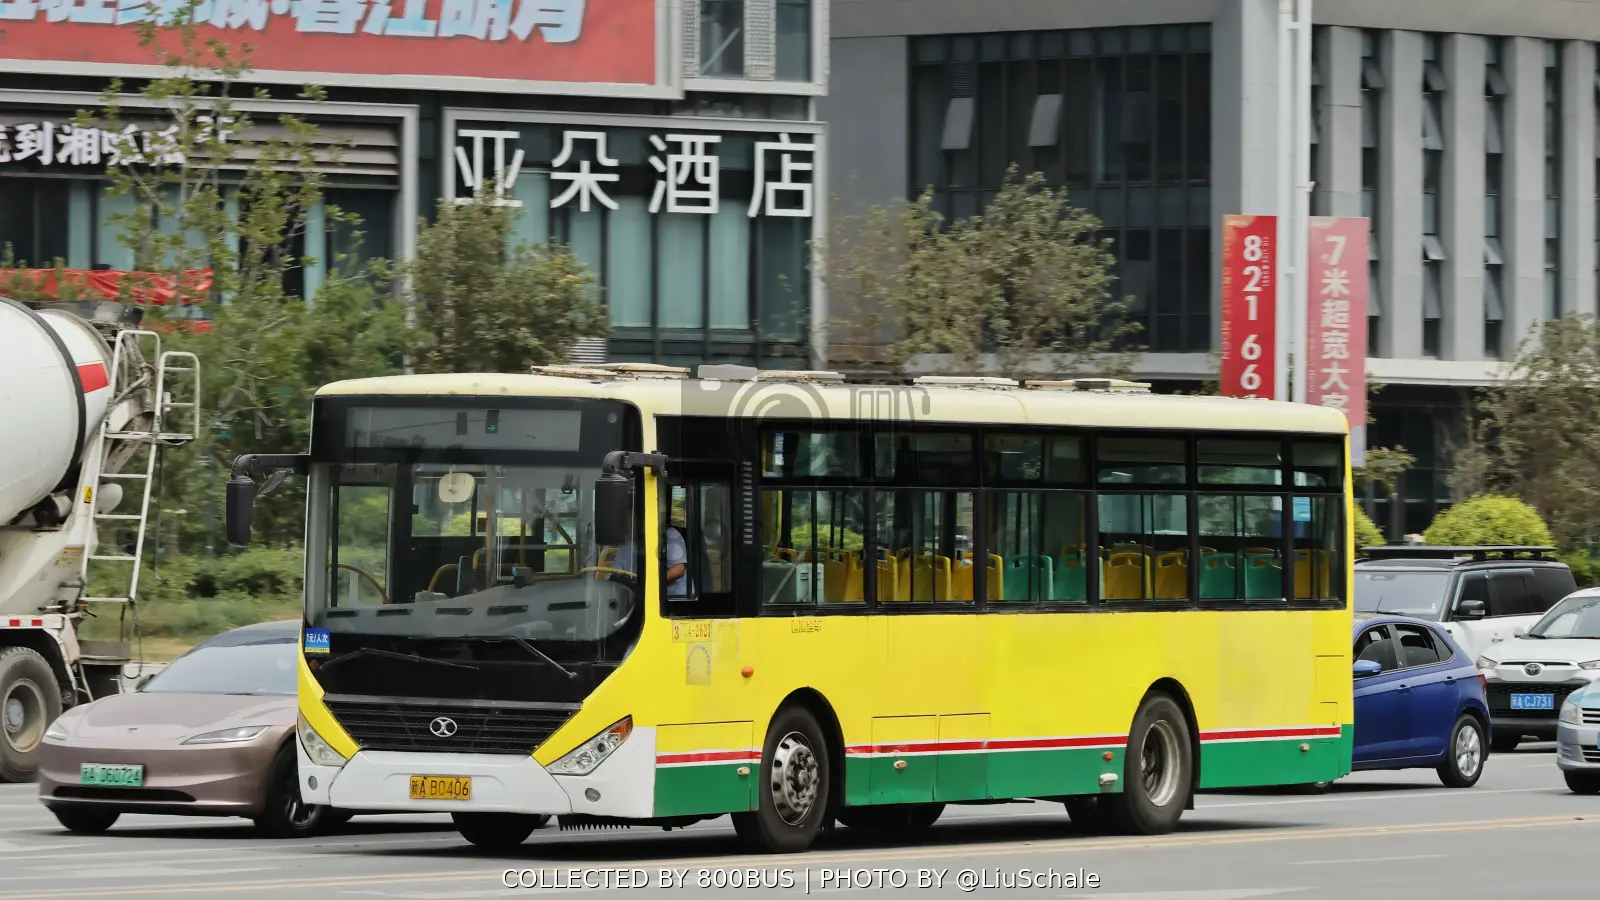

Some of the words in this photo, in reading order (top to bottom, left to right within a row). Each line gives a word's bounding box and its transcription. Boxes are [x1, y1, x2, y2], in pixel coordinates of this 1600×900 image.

[455, 129, 816, 218] 亚朵酒店
[1240, 333, 1262, 398] 66
